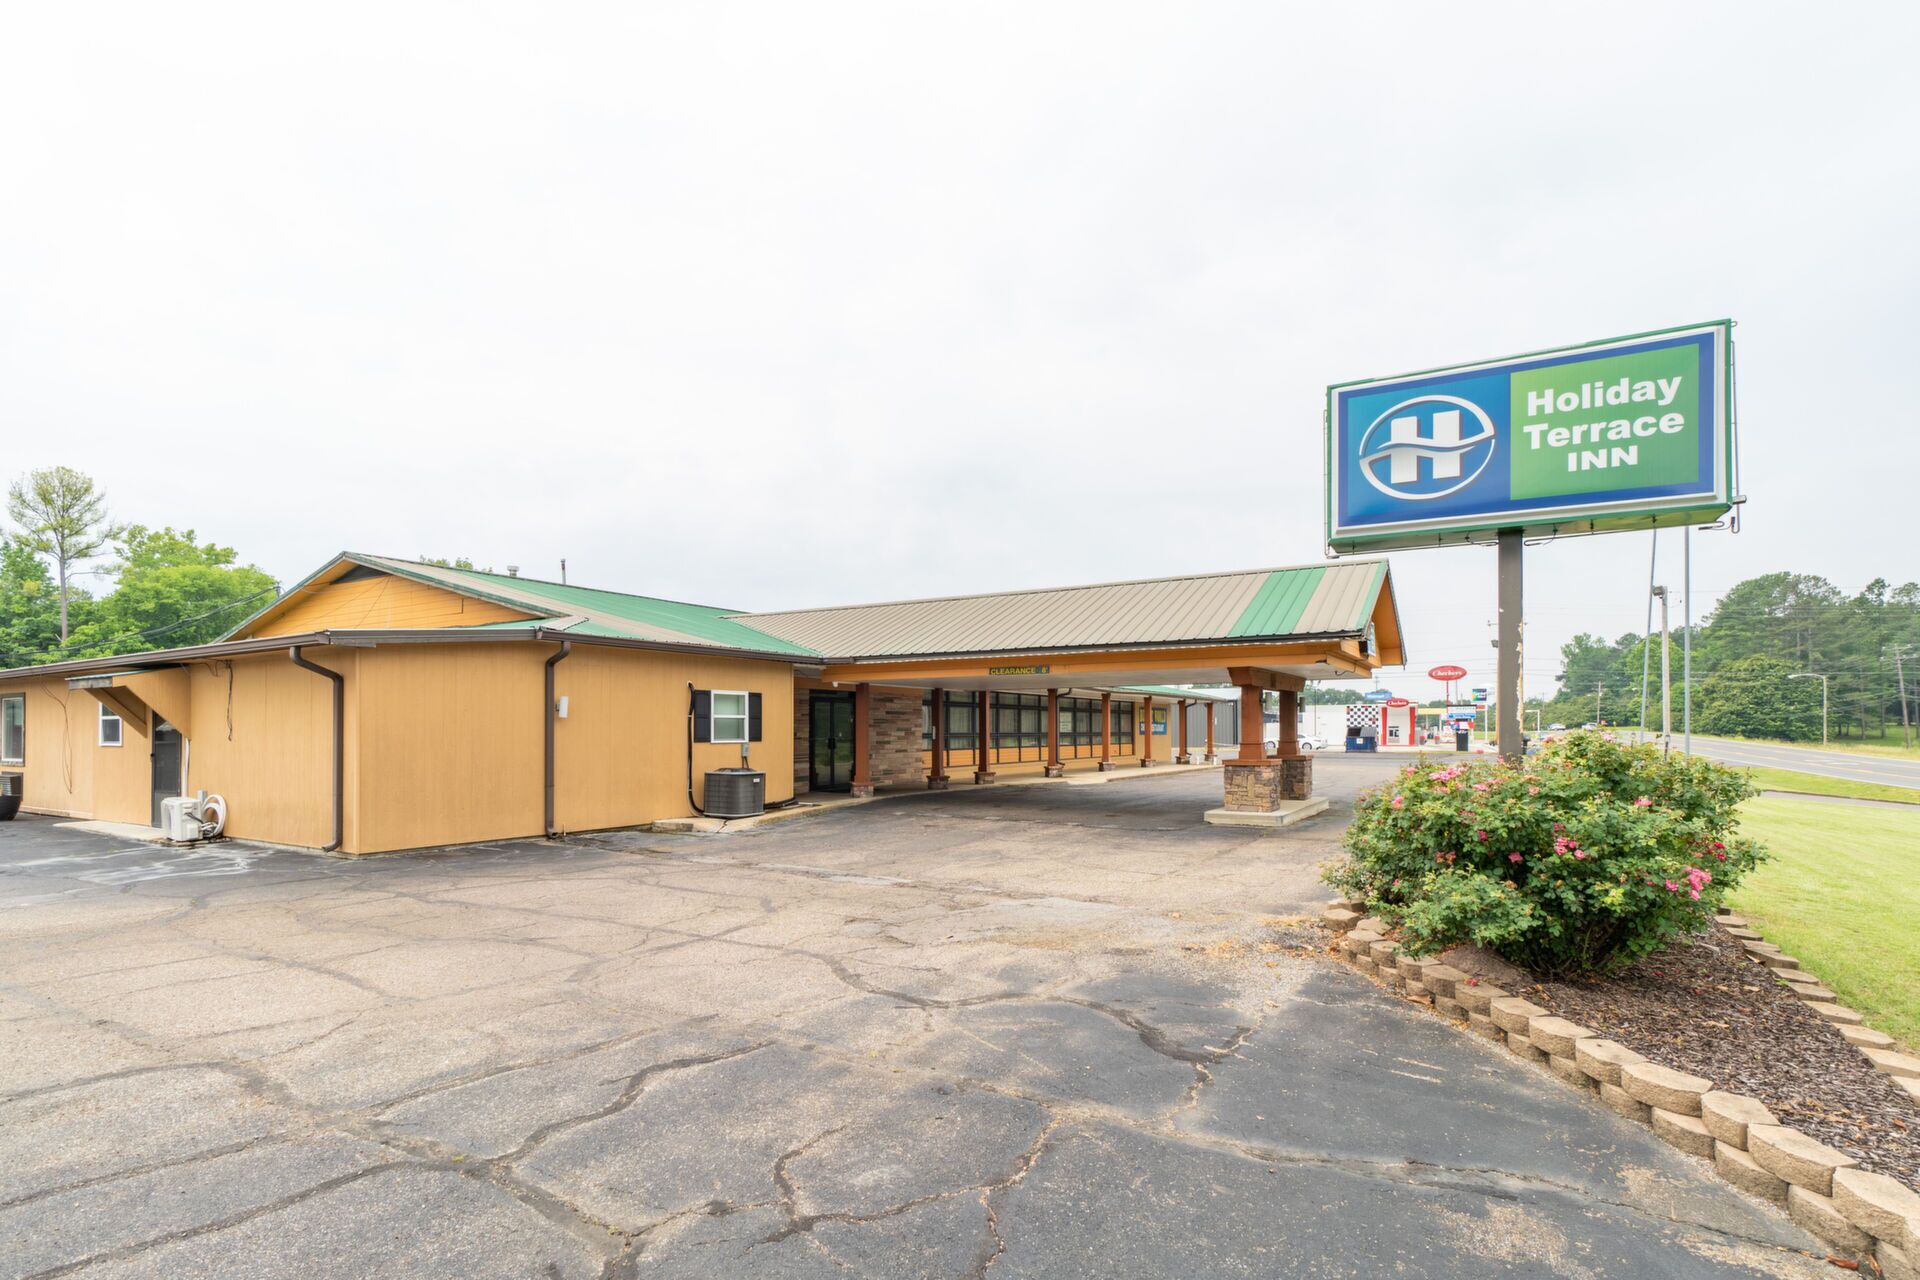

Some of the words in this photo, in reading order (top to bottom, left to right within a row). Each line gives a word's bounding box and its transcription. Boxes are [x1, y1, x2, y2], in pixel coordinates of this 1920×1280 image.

[1527, 376, 1682, 416] Holiday
[1390, 409, 1461, 484] H
[1523, 412, 1685, 450] Terrace
[1567, 445, 1639, 472] INN
[990, 667, 1036, 675] CLEARANCE
